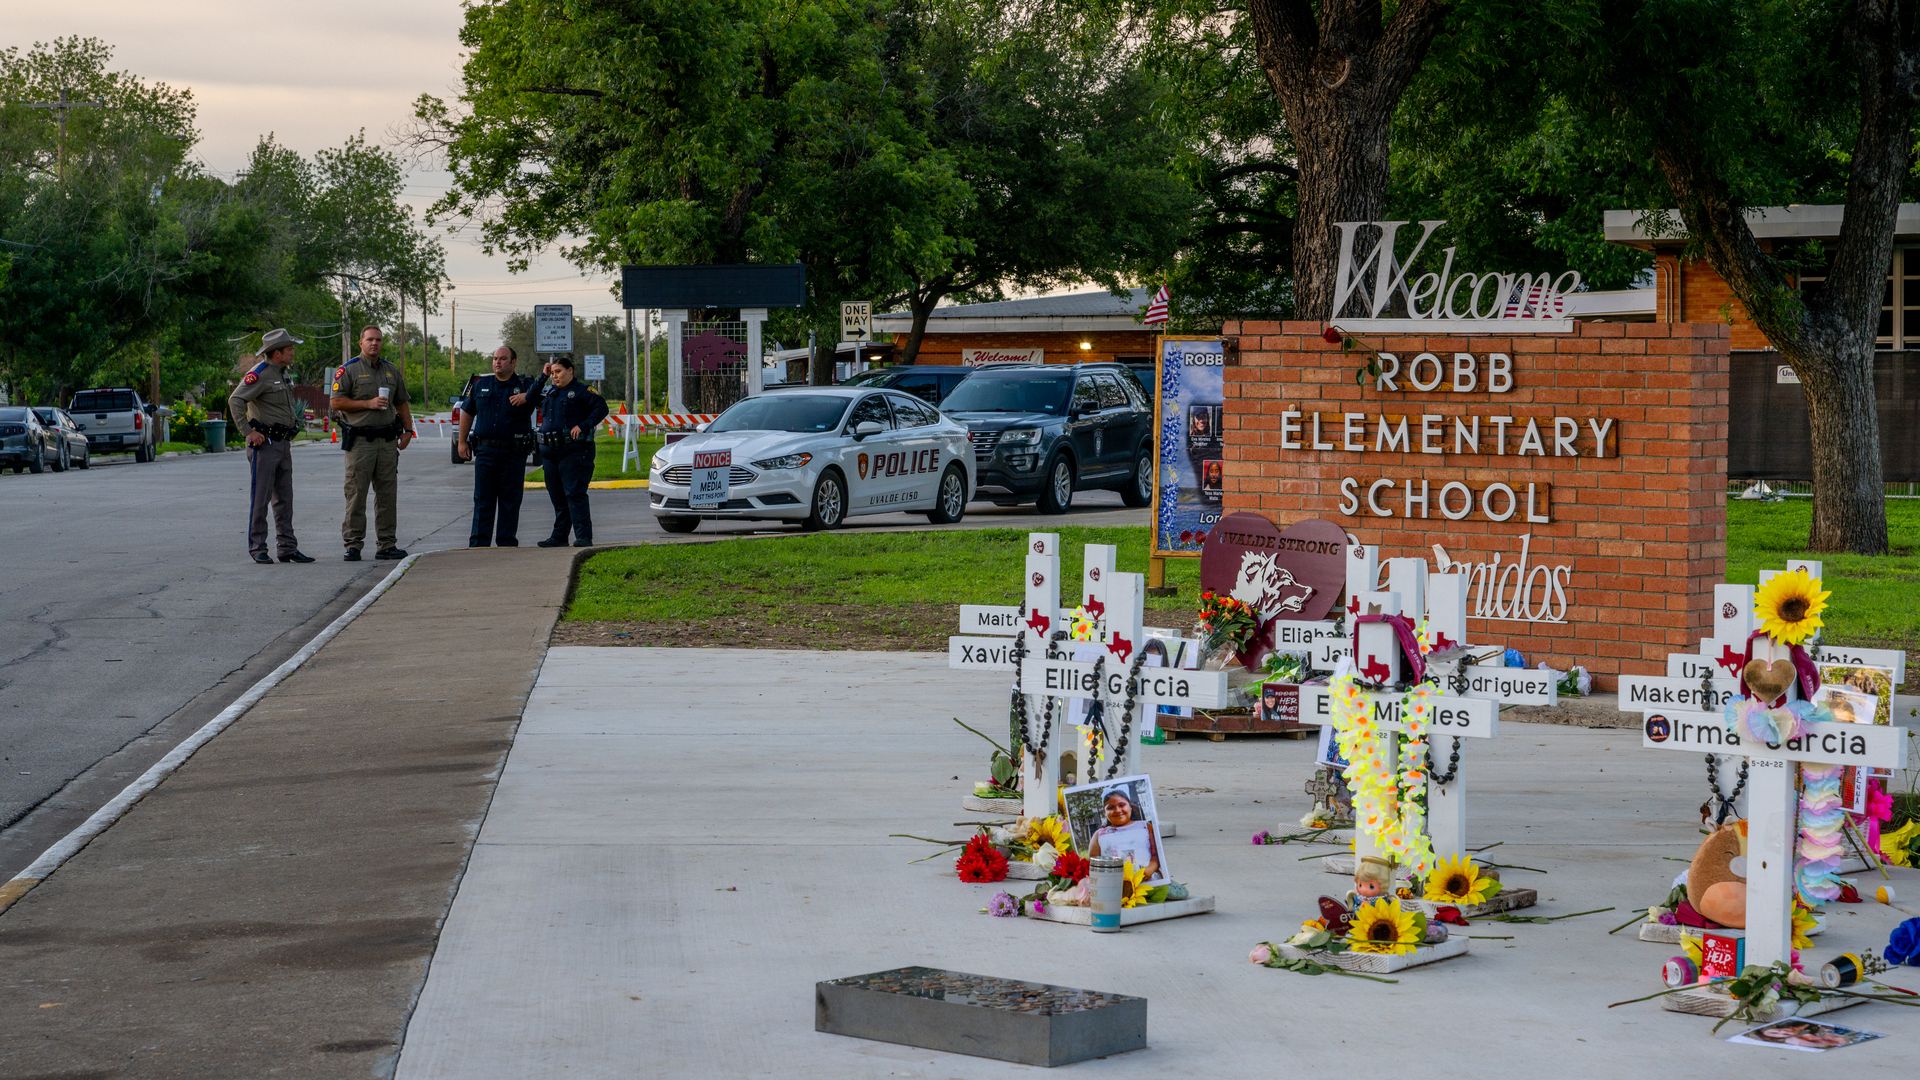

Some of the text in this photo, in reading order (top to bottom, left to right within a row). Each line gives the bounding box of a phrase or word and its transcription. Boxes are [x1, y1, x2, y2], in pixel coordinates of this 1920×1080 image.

[1332, 220, 1581, 320] Welcome
[845, 305, 868, 315] ONE
[844, 316, 868, 326] WAY
[973, 350, 1035, 362] Welcome!
[1184, 353, 1223, 366] ROBB
[1377, 352, 1513, 393] ROBB
[1281, 410, 1613, 458] ELEMENTARY
[695, 453, 730, 467] NOTICE
[871, 448, 939, 479] POLICE
[707, 470, 718, 481] NO
[700, 481, 722, 491] MEDIA
[870, 491, 918, 505] UVALDE CISD
[1339, 477, 1549, 524] SCHOOL
[1200, 513, 1223, 524] Lor
[1278, 537, 1341, 556] STRONG
[1046, 668, 1094, 691] Ellie
[1447, 675, 1549, 697] Rodriguez
[1374, 701, 1470, 727] Miles
[1673, 719, 1741, 745] Irma
[1707, 950, 1731, 965] HELP
